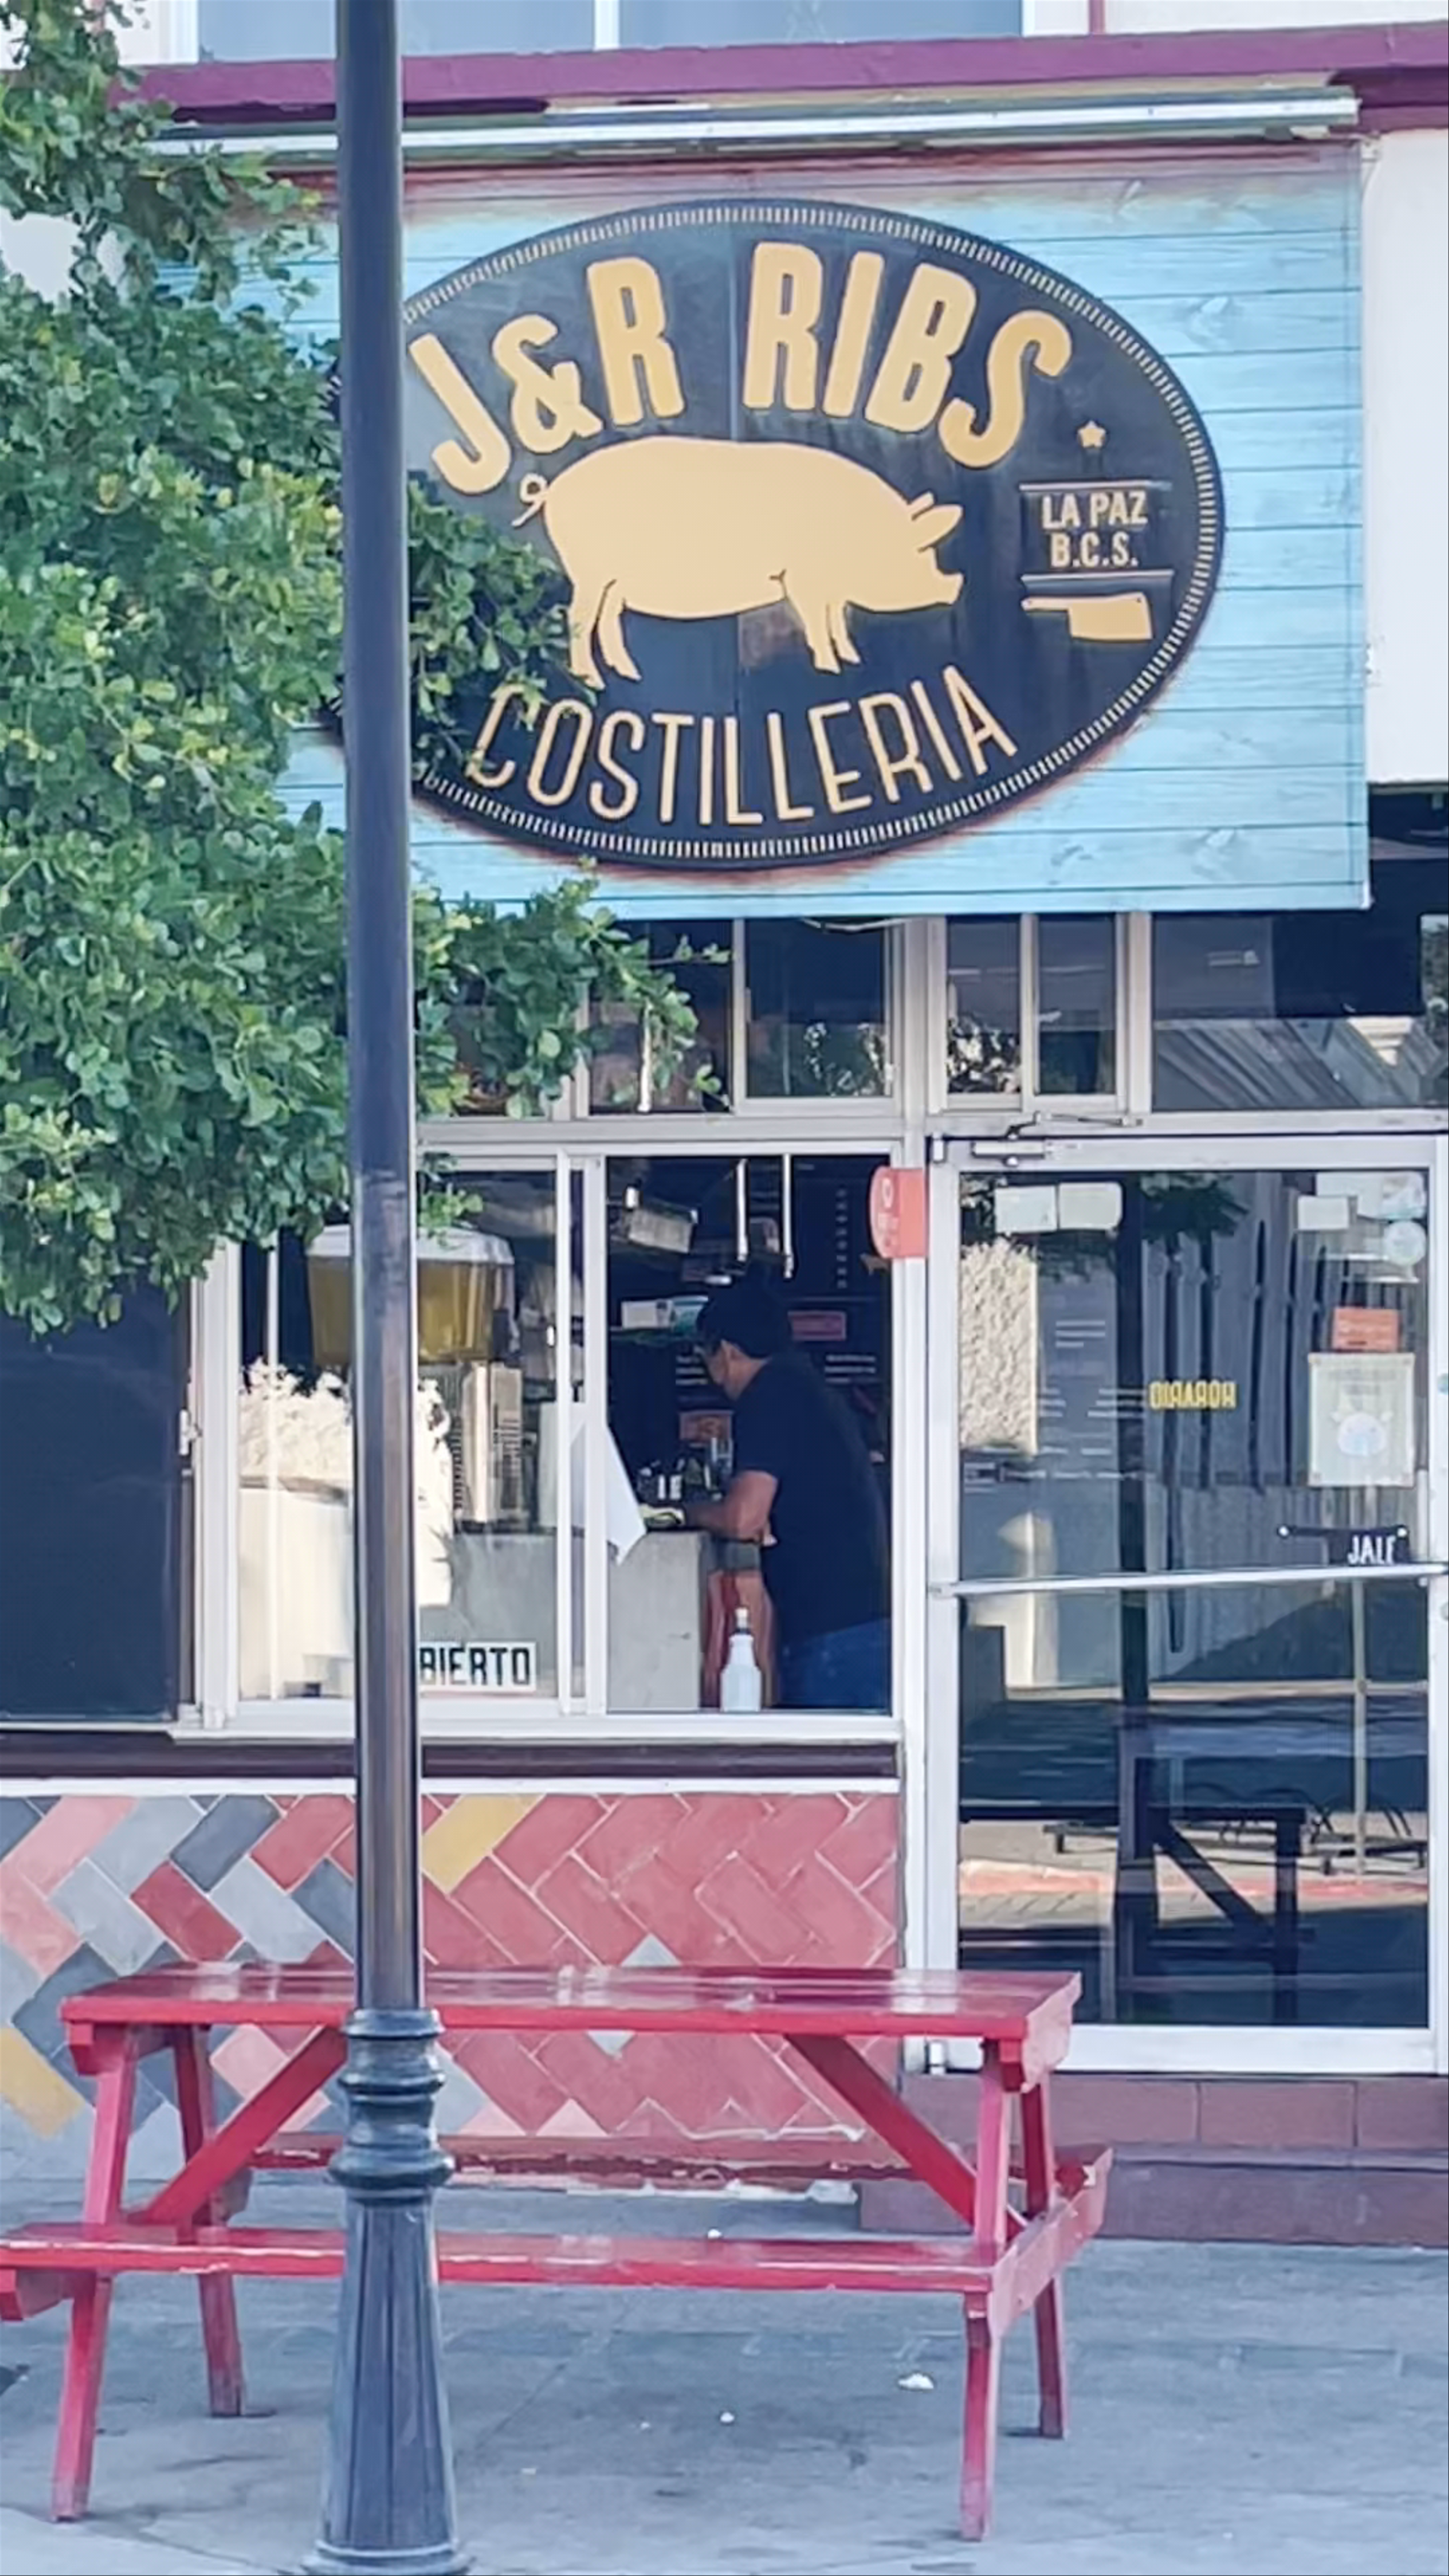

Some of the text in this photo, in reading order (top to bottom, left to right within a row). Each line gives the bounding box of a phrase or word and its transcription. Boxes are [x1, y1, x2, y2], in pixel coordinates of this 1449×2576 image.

[408, 242, 1072, 494] J&R RIBS
[1043, 490, 1148, 529] LA PAZ
[1051, 531, 1138, 567] B.C.S.
[466, 665, 1018, 824] COSTILLERIA
[420, 1647, 531, 1686] BIERTO
